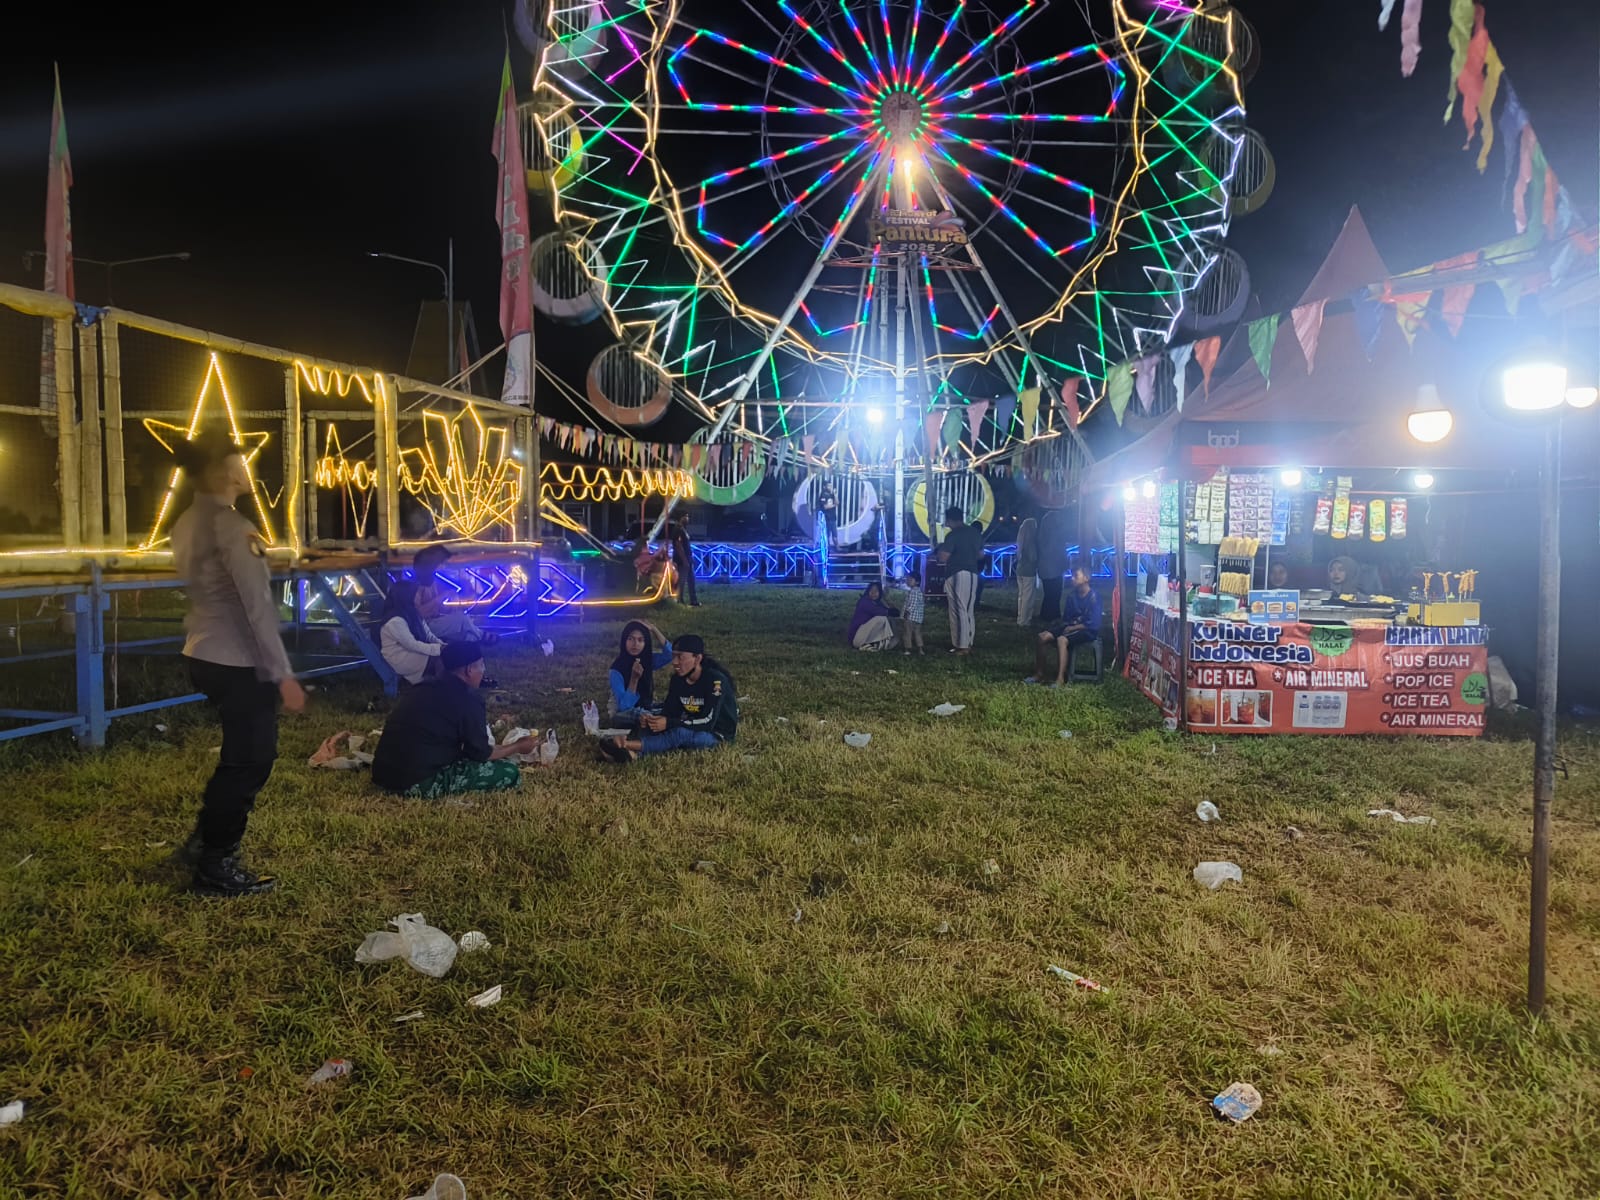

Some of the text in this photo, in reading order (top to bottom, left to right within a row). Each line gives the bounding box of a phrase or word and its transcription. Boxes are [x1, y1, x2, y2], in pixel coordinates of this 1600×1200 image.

[886, 217, 931, 225] FESTIVAL
[868, 219, 968, 245] Pantura
[899, 243, 936, 251] 2025
[1190, 642, 1313, 664] Indonesia
[1394, 654, 1470, 667] JUS BUAH
[1197, 669, 1255, 686] ICE TEA
[1285, 671, 1369, 688] AIR MINERAL
[1395, 674, 1454, 687] POP ICE
[1393, 694, 1450, 707] ICE TEA
[1391, 714, 1485, 727] AIR MINERAL
